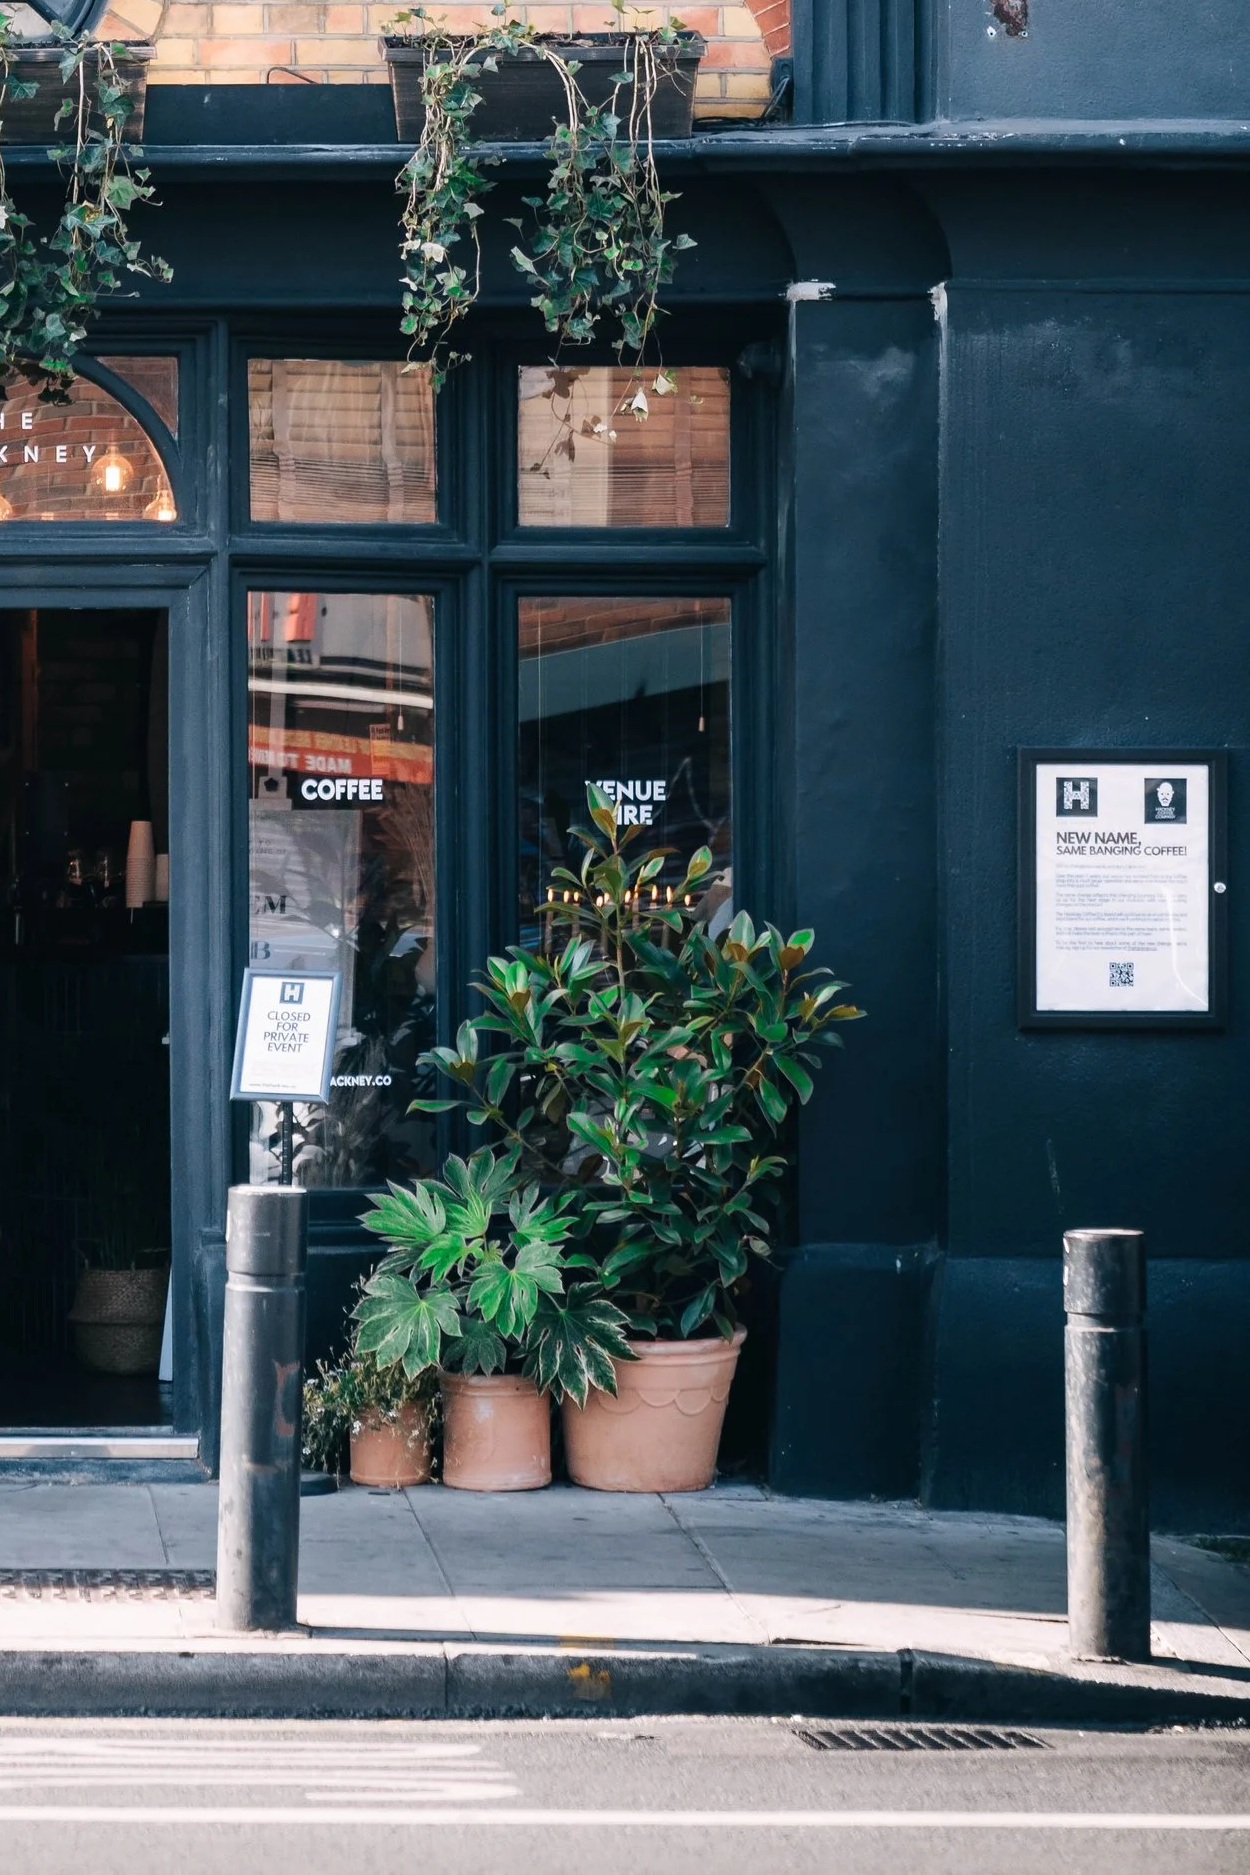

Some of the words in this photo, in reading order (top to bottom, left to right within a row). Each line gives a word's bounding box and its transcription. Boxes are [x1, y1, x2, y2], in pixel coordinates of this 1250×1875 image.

[301, 778, 383, 801] COFFEE
[617, 804, 653, 825] IRE
[1056, 832, 1091, 844] NEW
[1094, 832, 1142, 847] NAME,
[1056, 846, 1087, 856] SAME
[1089, 846, 1142, 856] BANGING
[1143, 846, 1188, 856] COFFEE!
[267, 1010, 311, 1022] CLOSED
[276, 1021, 298, 1031] FOR
[263, 1031, 310, 1043] PRIVATE
[267, 1042, 303, 1053] EVENT
[330, 1075, 392, 1087] ACKNEY.CO
